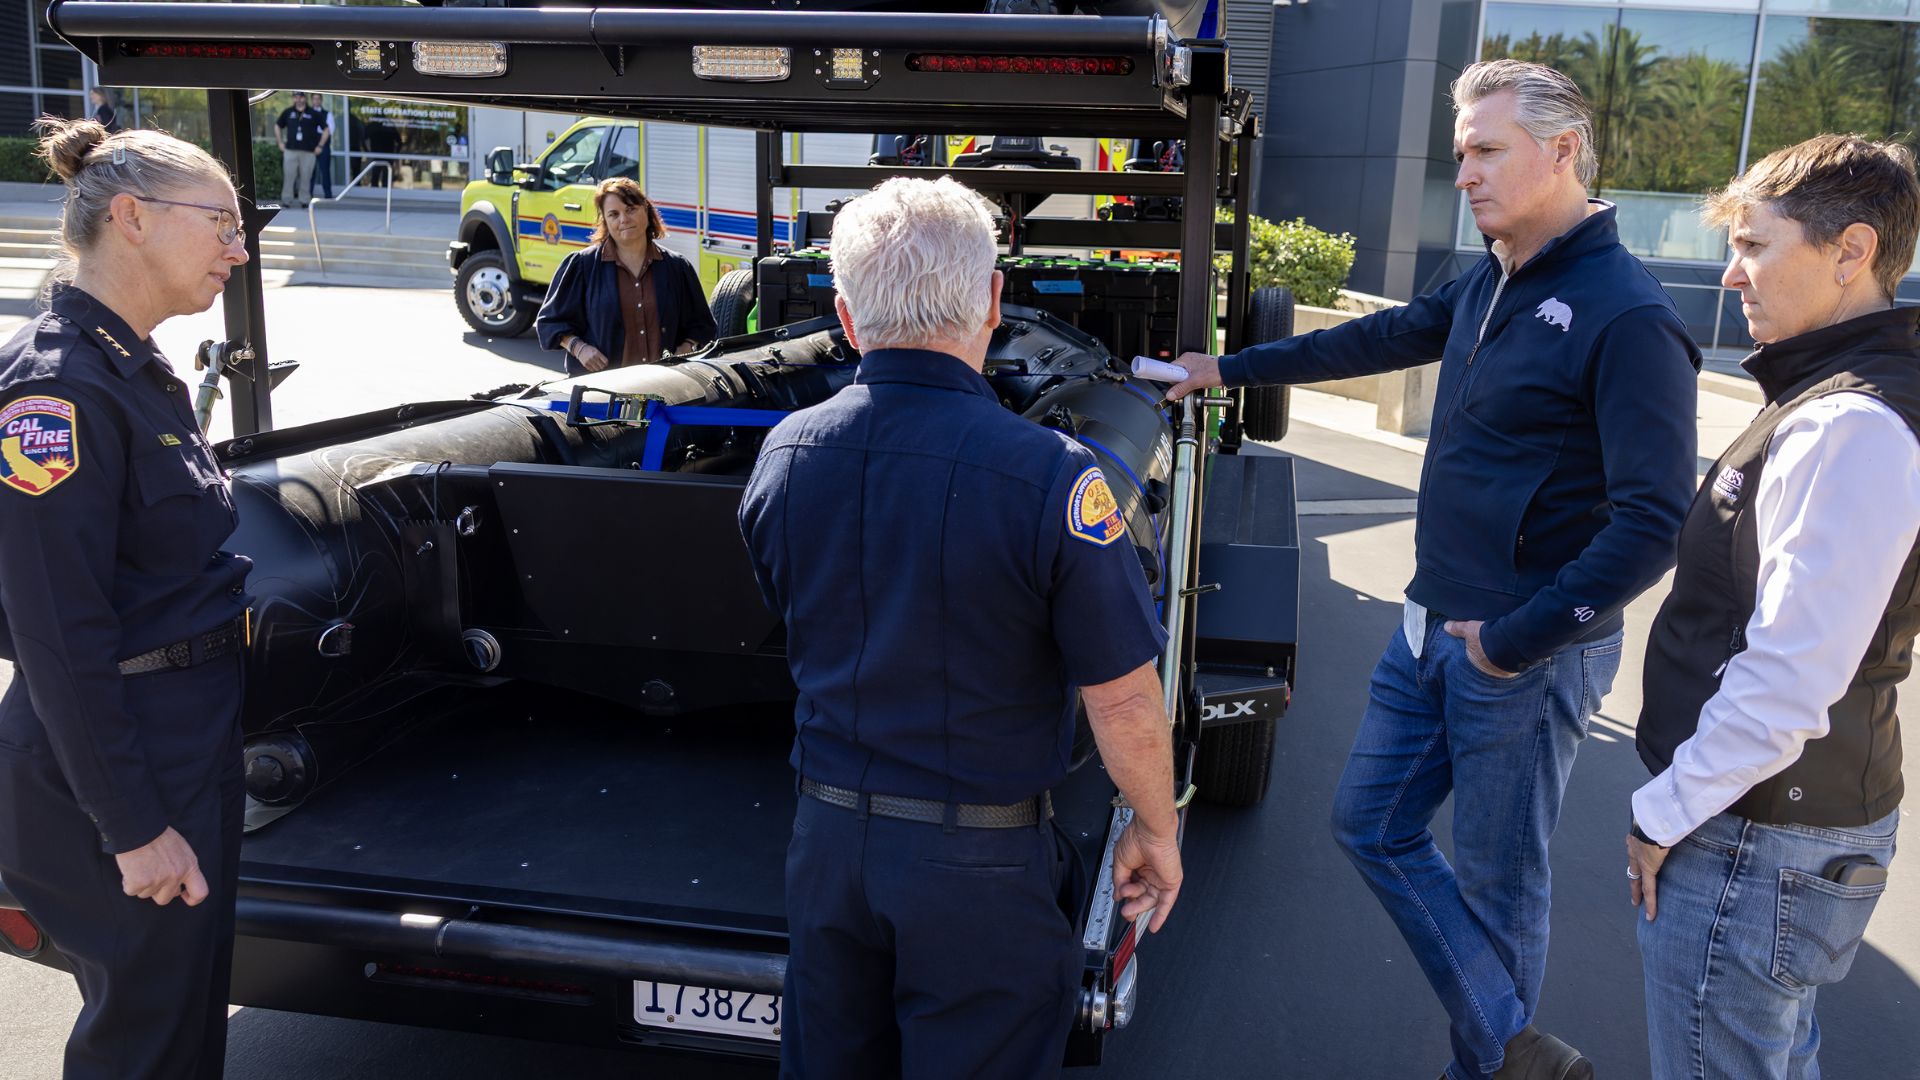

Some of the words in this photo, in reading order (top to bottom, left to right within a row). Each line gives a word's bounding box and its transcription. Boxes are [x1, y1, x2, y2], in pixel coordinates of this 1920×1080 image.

[360, 106, 382, 115] STATE
[383, 107, 429, 117] OPERATIONS
[429, 110, 457, 119] CENTER
[7, 418, 43, 435] CAL
[23, 429, 71, 447] FIRE
[1574, 606, 1595, 622] 40
[645, 982, 780, 1025] 173823
